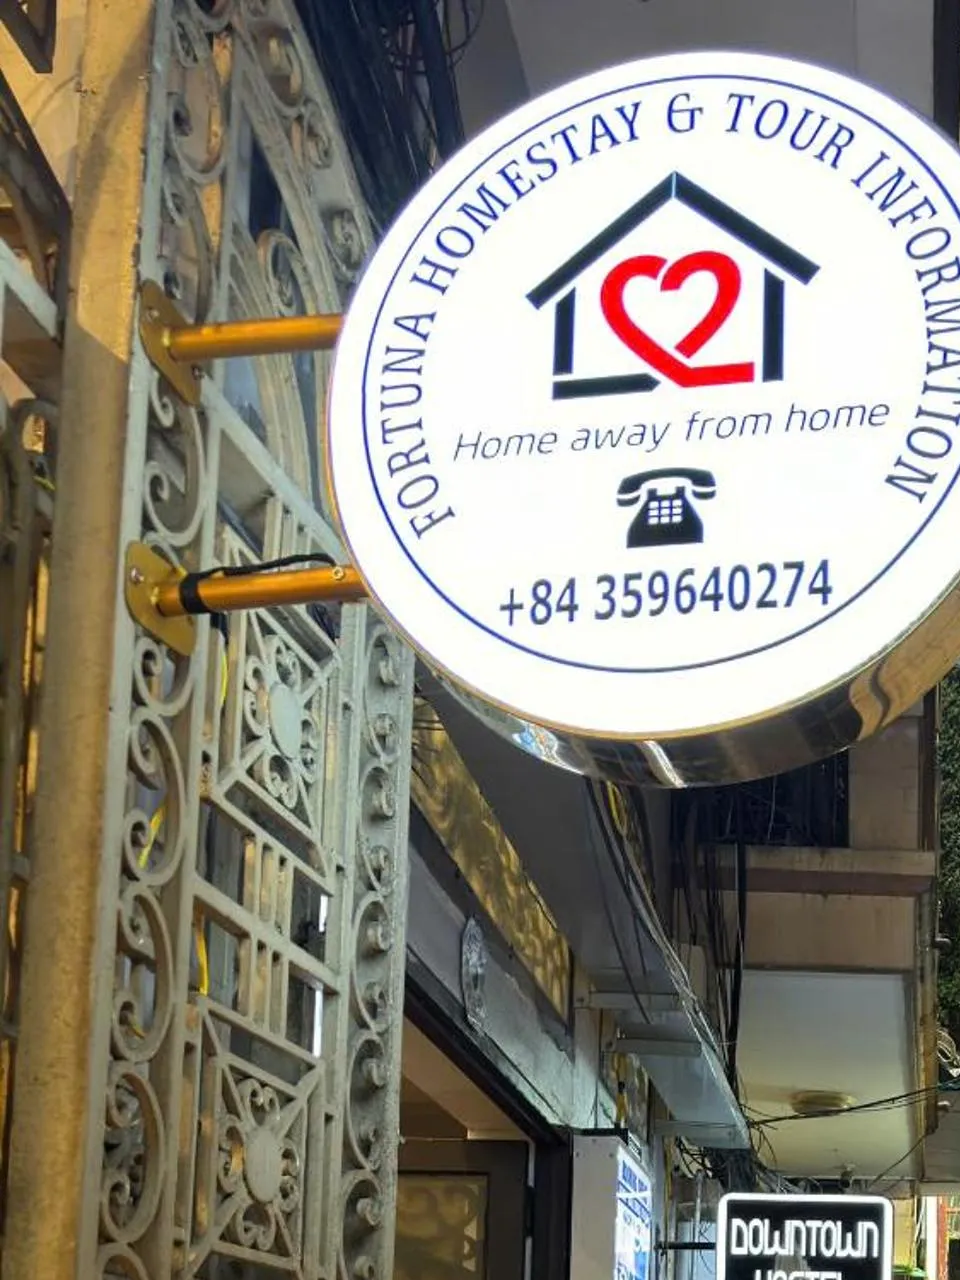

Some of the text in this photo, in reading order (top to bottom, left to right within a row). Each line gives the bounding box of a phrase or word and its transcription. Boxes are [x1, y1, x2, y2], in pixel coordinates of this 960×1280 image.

[726, 92, 855, 171] TOUR
[411, 101, 644, 295] HOMESTAY
[380, 309, 456, 540] FORTUNA
[453, 401, 890, 462] Home away from home
[500, 559, 832, 626] +84 359640274
[731, 1218, 879, 1258] DOWNTOWN
